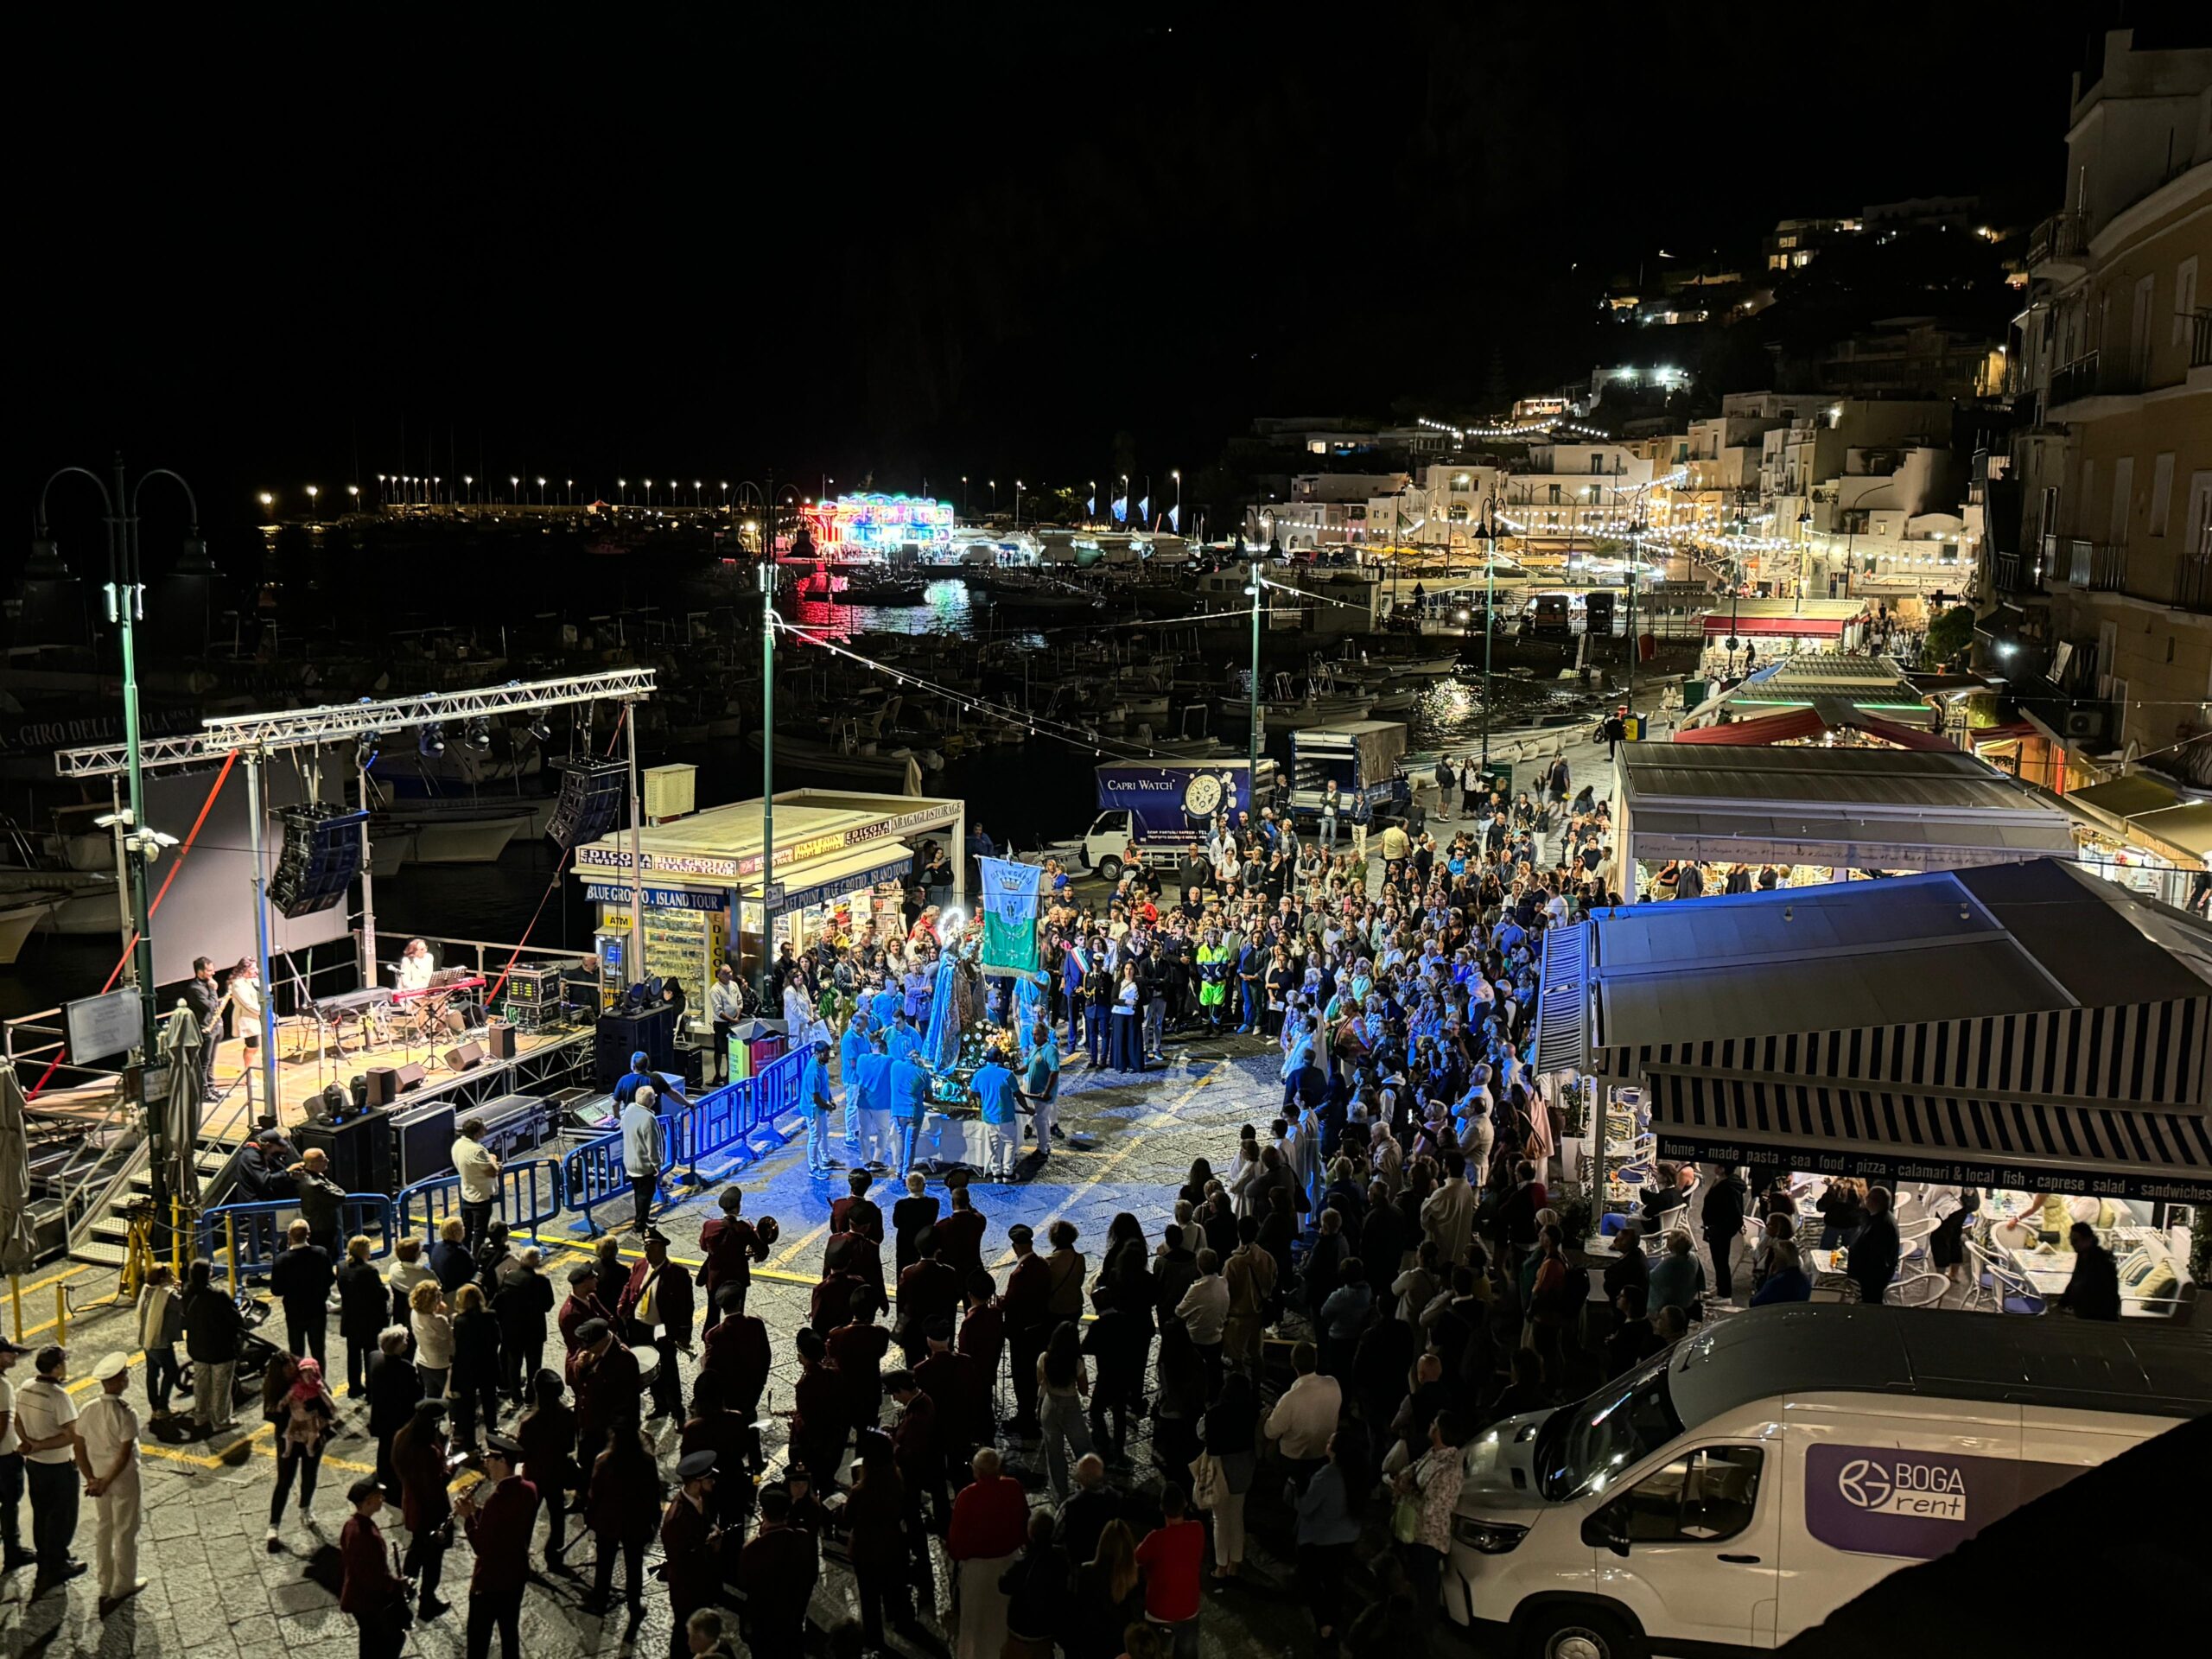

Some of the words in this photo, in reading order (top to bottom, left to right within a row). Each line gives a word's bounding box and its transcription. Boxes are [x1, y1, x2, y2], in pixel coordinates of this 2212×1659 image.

[19, 721, 66, 747] GIRO
[1107, 779, 1136, 790] CAPRI
[846, 822, 889, 840] EDICOLA
[580, 849, 652, 862] EDICOA
[580, 856, 652, 869] NEWSPAPRS
[655, 856, 683, 866] BLUE
[685, 858, 734, 869] GROTTO
[655, 862, 697, 874] ISLAND
[699, 866, 734, 876] TOUR
[798, 888, 820, 908] POINT
[823, 884, 840, 900] BLUE
[841, 874, 868, 894] GROTTO
[871, 865, 893, 884] ISLAND
[893, 859, 910, 876] TOUR
[586, 886, 609, 900] BLUE
[610, 887, 649, 904] GROO
[656, 891, 690, 906] ISLAND
[691, 894, 718, 909] TOUR
[609, 917, 628, 925] ATM
[1664, 1141, 1695, 1157] home
[1708, 1146, 1739, 1161] made
[1746, 1150, 1779, 1165] pasta
[1790, 1154, 1811, 1167] sea
[1819, 1155, 1845, 1171] food
[1856, 1159, 1886, 1175] pizza
[1897, 1163, 1949, 1180] calamari
[1954, 1166, 1963, 1180] &
[1966, 1167, 1994, 1183] local
[2003, 1170, 2024, 1186] fish
[2037, 1175, 2085, 1192] caprese
[2092, 1179, 2126, 1194] salad
[2140, 1183, 2212, 1201] sandwiches
[1895, 1462, 1966, 1494] BOGA
[1895, 1496, 1962, 1517] rent
